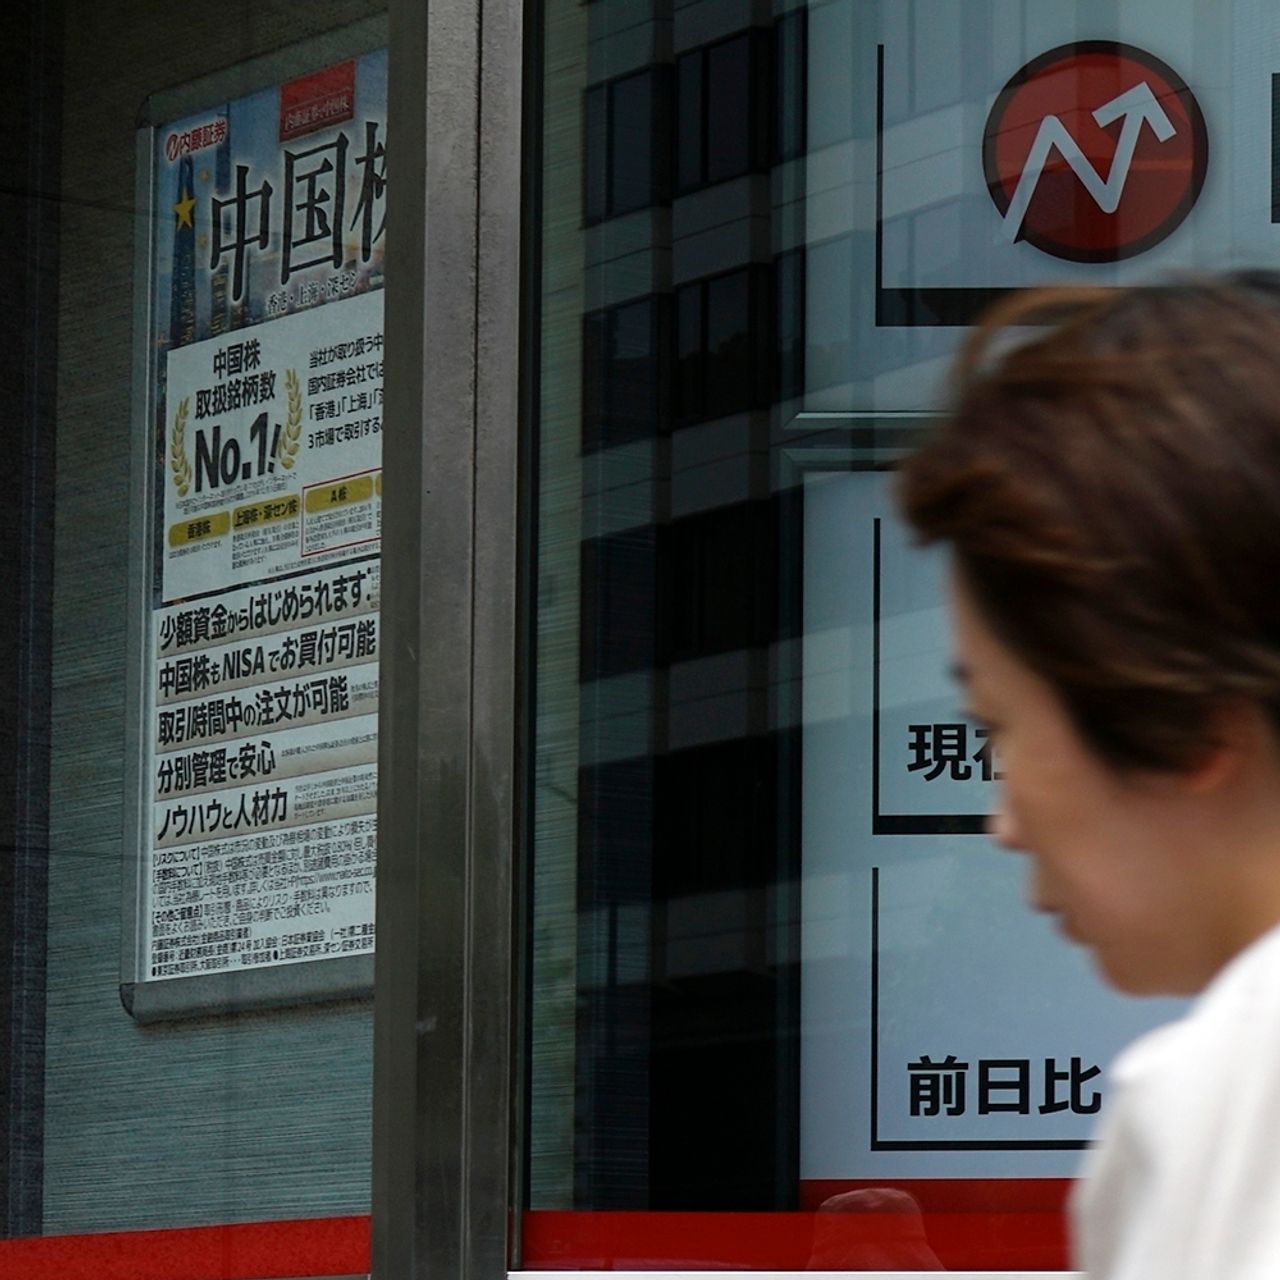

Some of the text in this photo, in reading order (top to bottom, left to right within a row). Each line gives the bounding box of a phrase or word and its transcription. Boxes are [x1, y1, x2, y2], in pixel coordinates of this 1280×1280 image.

[212, 337, 261, 379] 中国株
[195, 370, 276, 420] 取扱銘柄数
[194, 411, 282, 493] No.1!
[307, 416, 384, 450] 3市場で取引する
[158, 674, 350, 746] 取引時間中の注文が可能
[158, 739, 276, 794] 分別管理で安心
[157, 786, 289, 840] ノウハウと人材力
[907, 1054, 1102, 1118] 前日比
